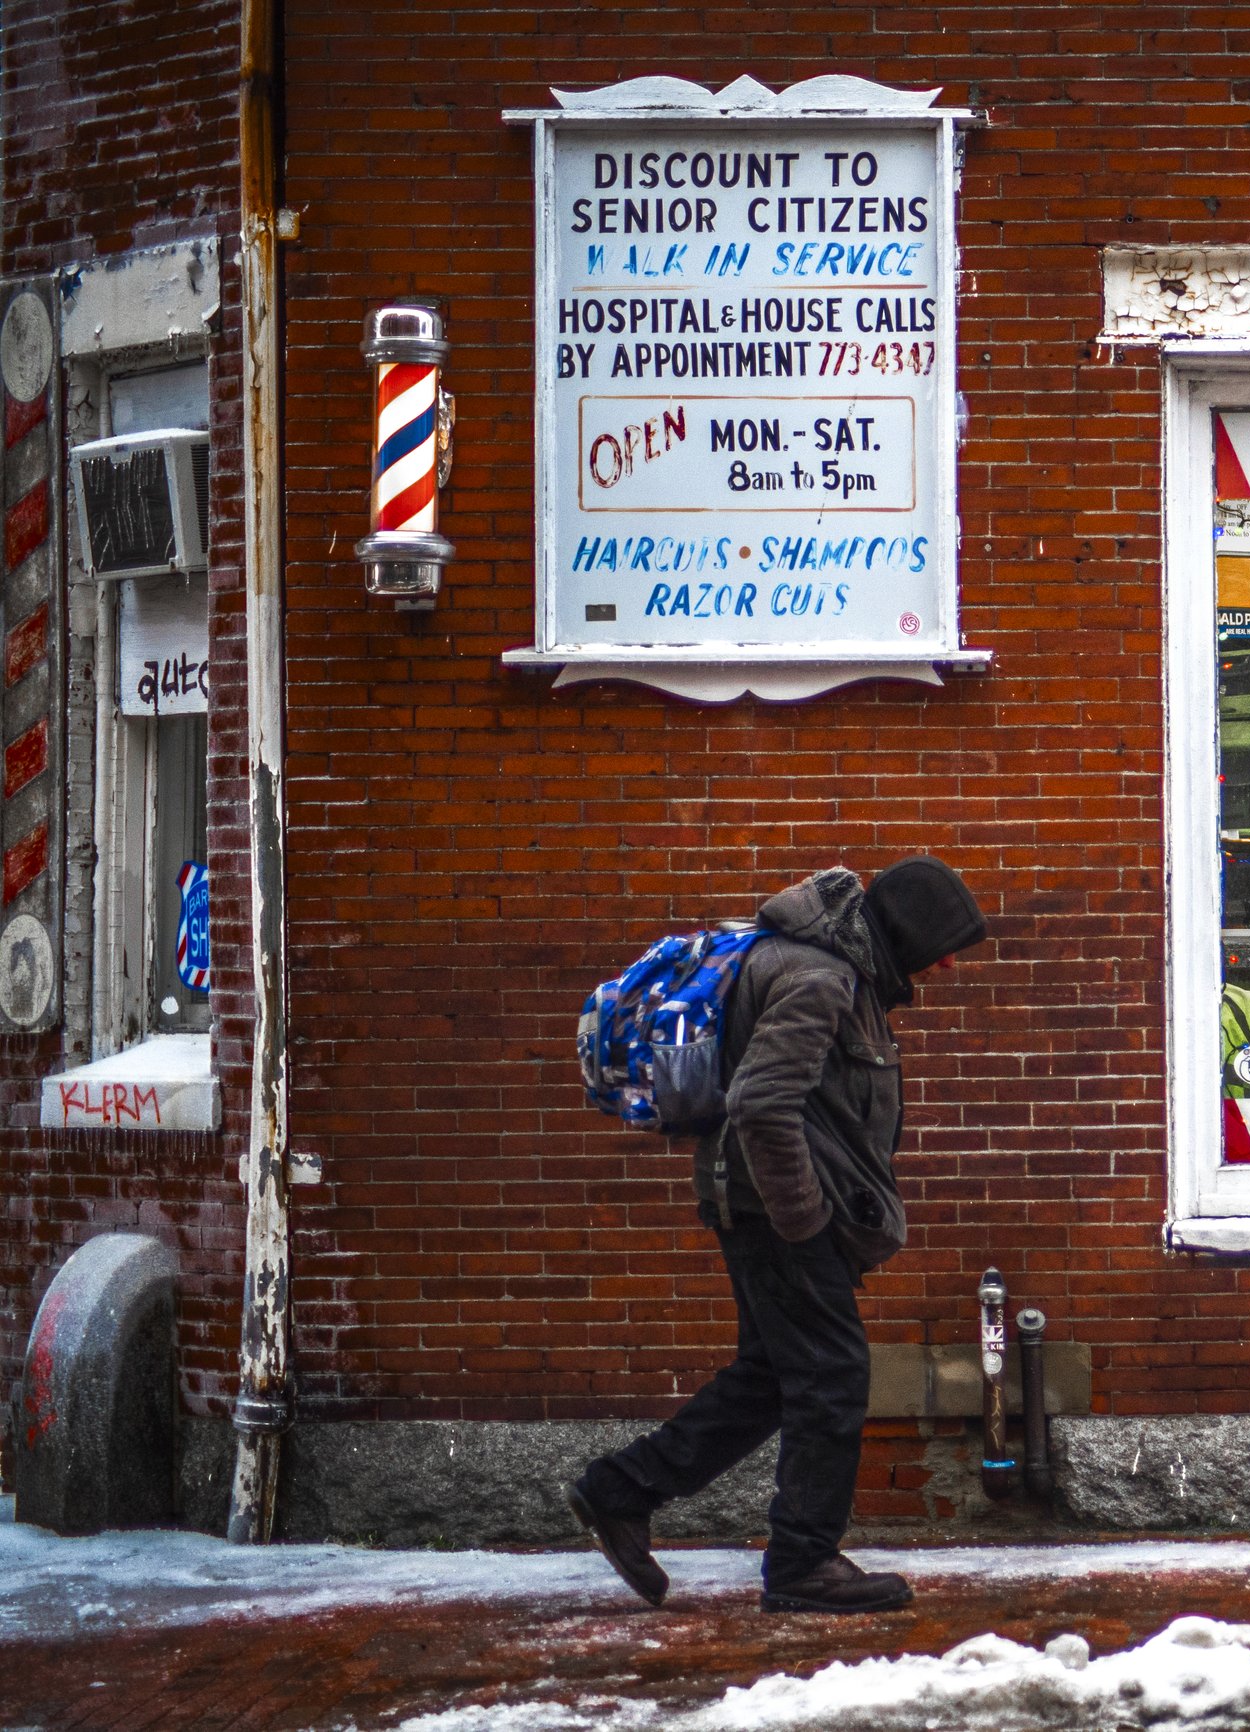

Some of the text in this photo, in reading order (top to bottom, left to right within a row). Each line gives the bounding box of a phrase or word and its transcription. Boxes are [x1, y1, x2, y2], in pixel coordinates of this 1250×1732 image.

[594, 151, 878, 189] DISCOUNT TO
[571, 196, 929, 233] SENIOR CITIZENS
[588, 242, 925, 277] WALK IN SERVICE
[558, 298, 936, 334] HOSPITAL & HOUSE CALLS
[557, 343, 595, 379] BY
[611, 341, 811, 377] APPOINTMENT
[590, 406, 687, 488] OPEN
[728, 461, 877, 499] 8am to 5pm
[572, 536, 929, 572] HAIRCUTS SHAMPOOS
[645, 583, 850, 617] RAZOR CUTS
[189, 889, 208, 916] BAR
[191, 917, 208, 957] SH
